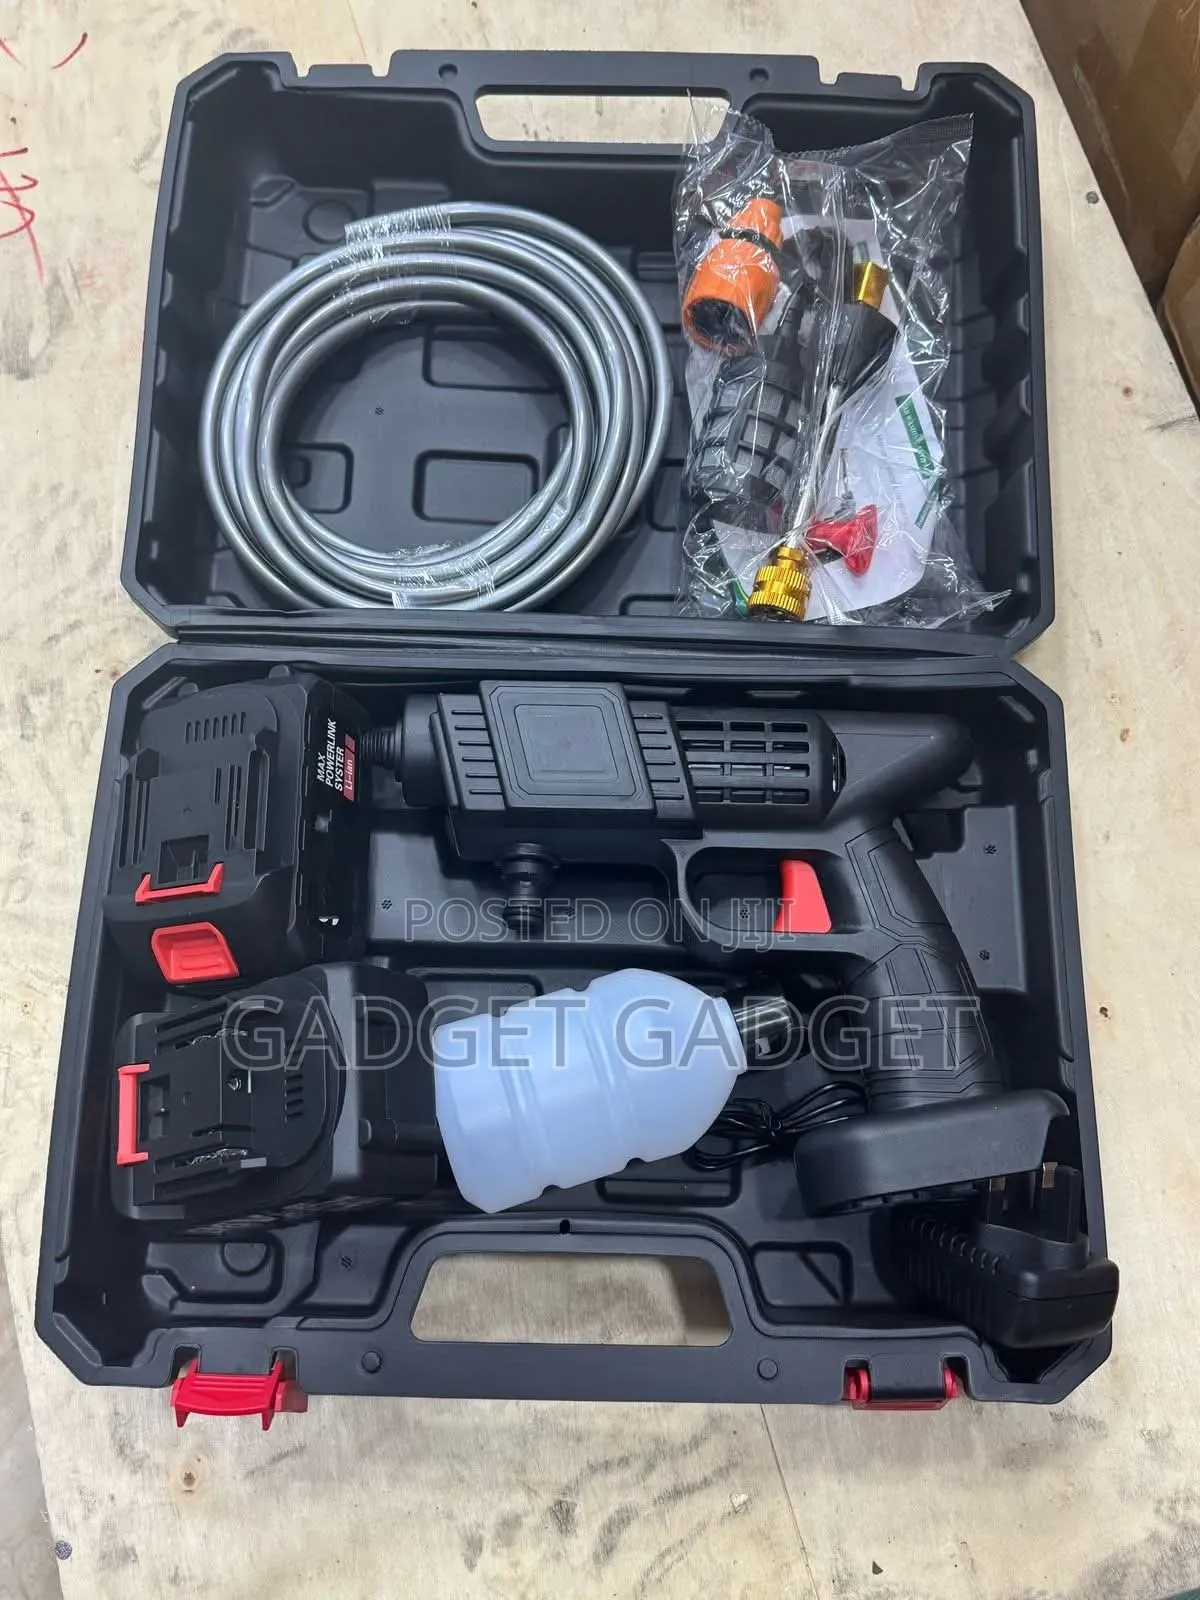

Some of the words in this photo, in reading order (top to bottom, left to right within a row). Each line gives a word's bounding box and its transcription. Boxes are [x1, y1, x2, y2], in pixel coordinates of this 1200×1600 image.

[317, 752, 326, 782] MAX
[325, 718, 337, 787] POWERLINK
[334, 746, 345, 792] SYSTER
